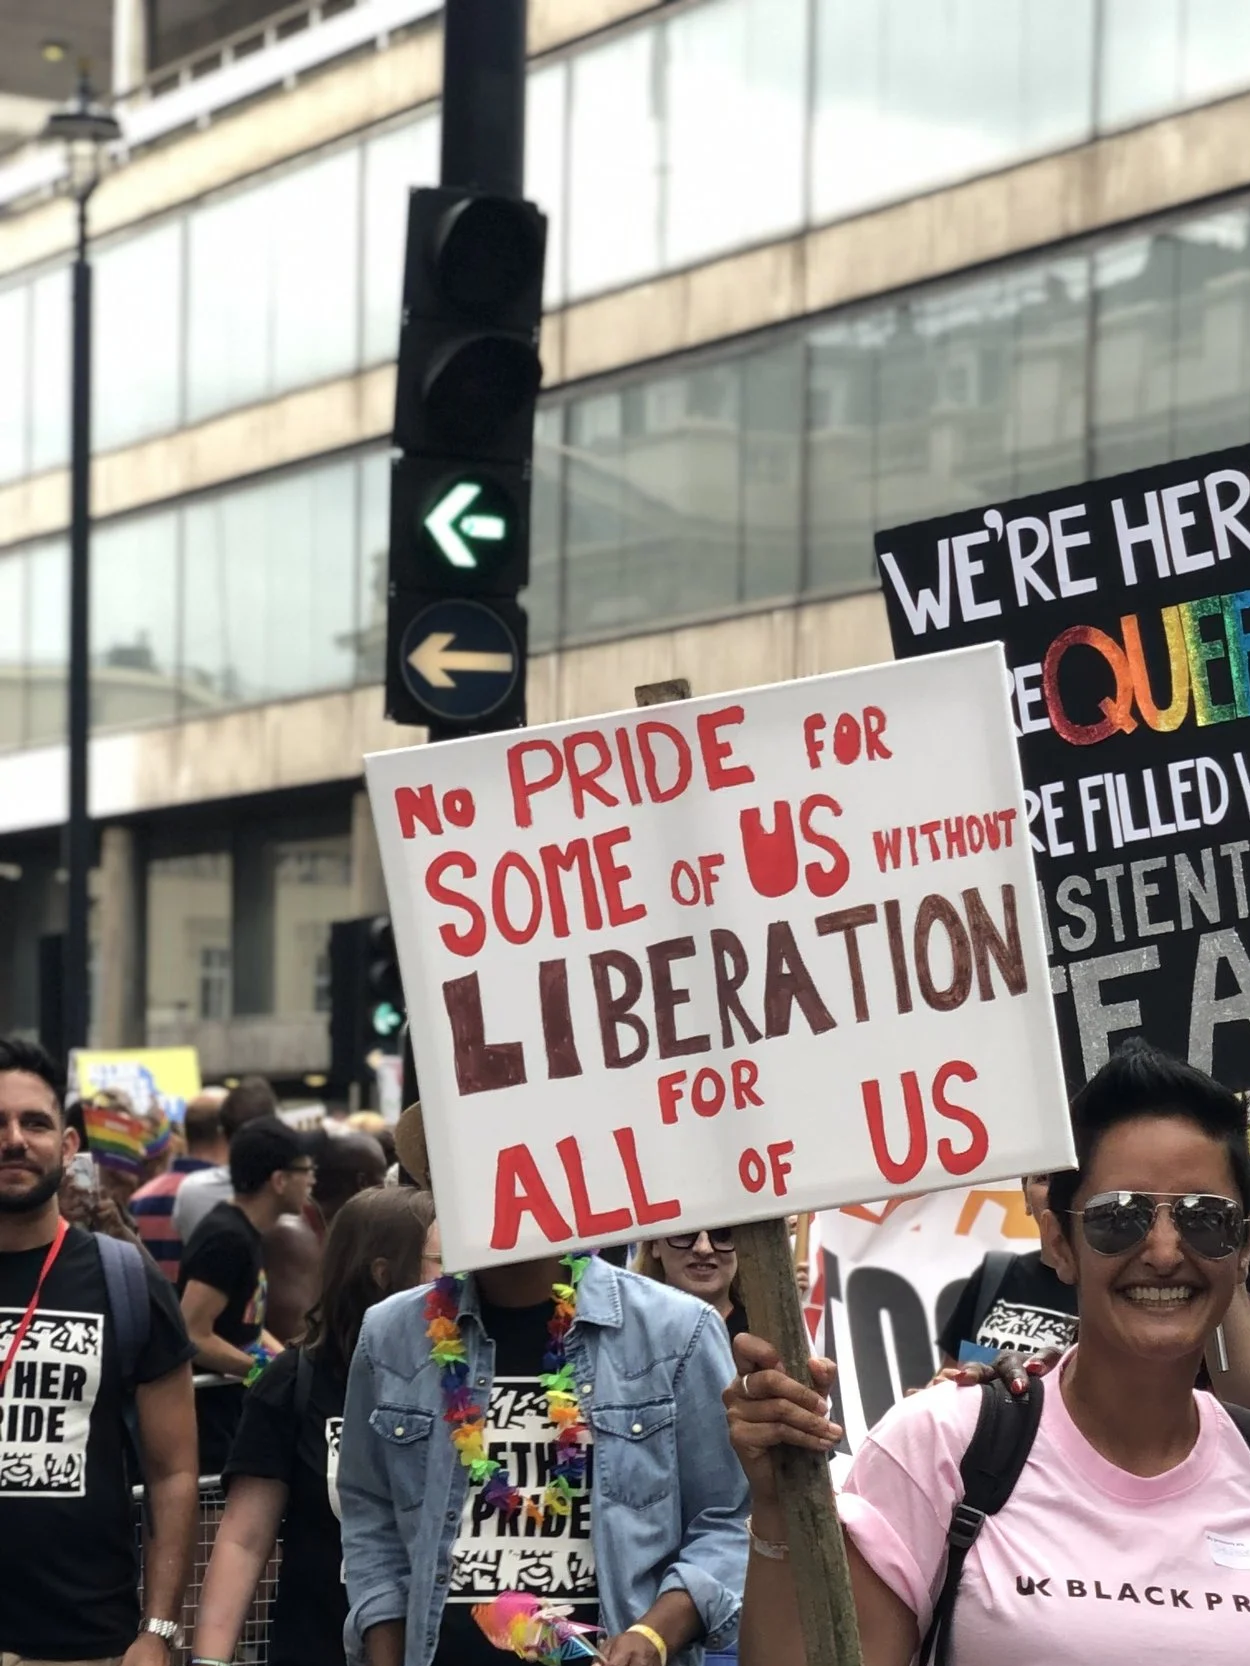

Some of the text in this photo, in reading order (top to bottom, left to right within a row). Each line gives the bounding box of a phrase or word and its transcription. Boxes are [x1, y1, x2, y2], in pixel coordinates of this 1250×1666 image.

[881, 504, 1097, 635] WE'RE
[507, 707, 754, 828] PRIDE
[806, 705, 892, 771] FOR
[1078, 756, 1229, 854] FILLED
[425, 795, 1017, 957] SOME OF US WITHOUT
[442, 884, 1028, 1096] LIBERATION
[490, 1060, 988, 1250] ALL OF US
[658, 1059, 764, 1124] FOR
[1016, 1575, 1052, 1597] UK
[1066, 1579, 1193, 1609] BLACK
